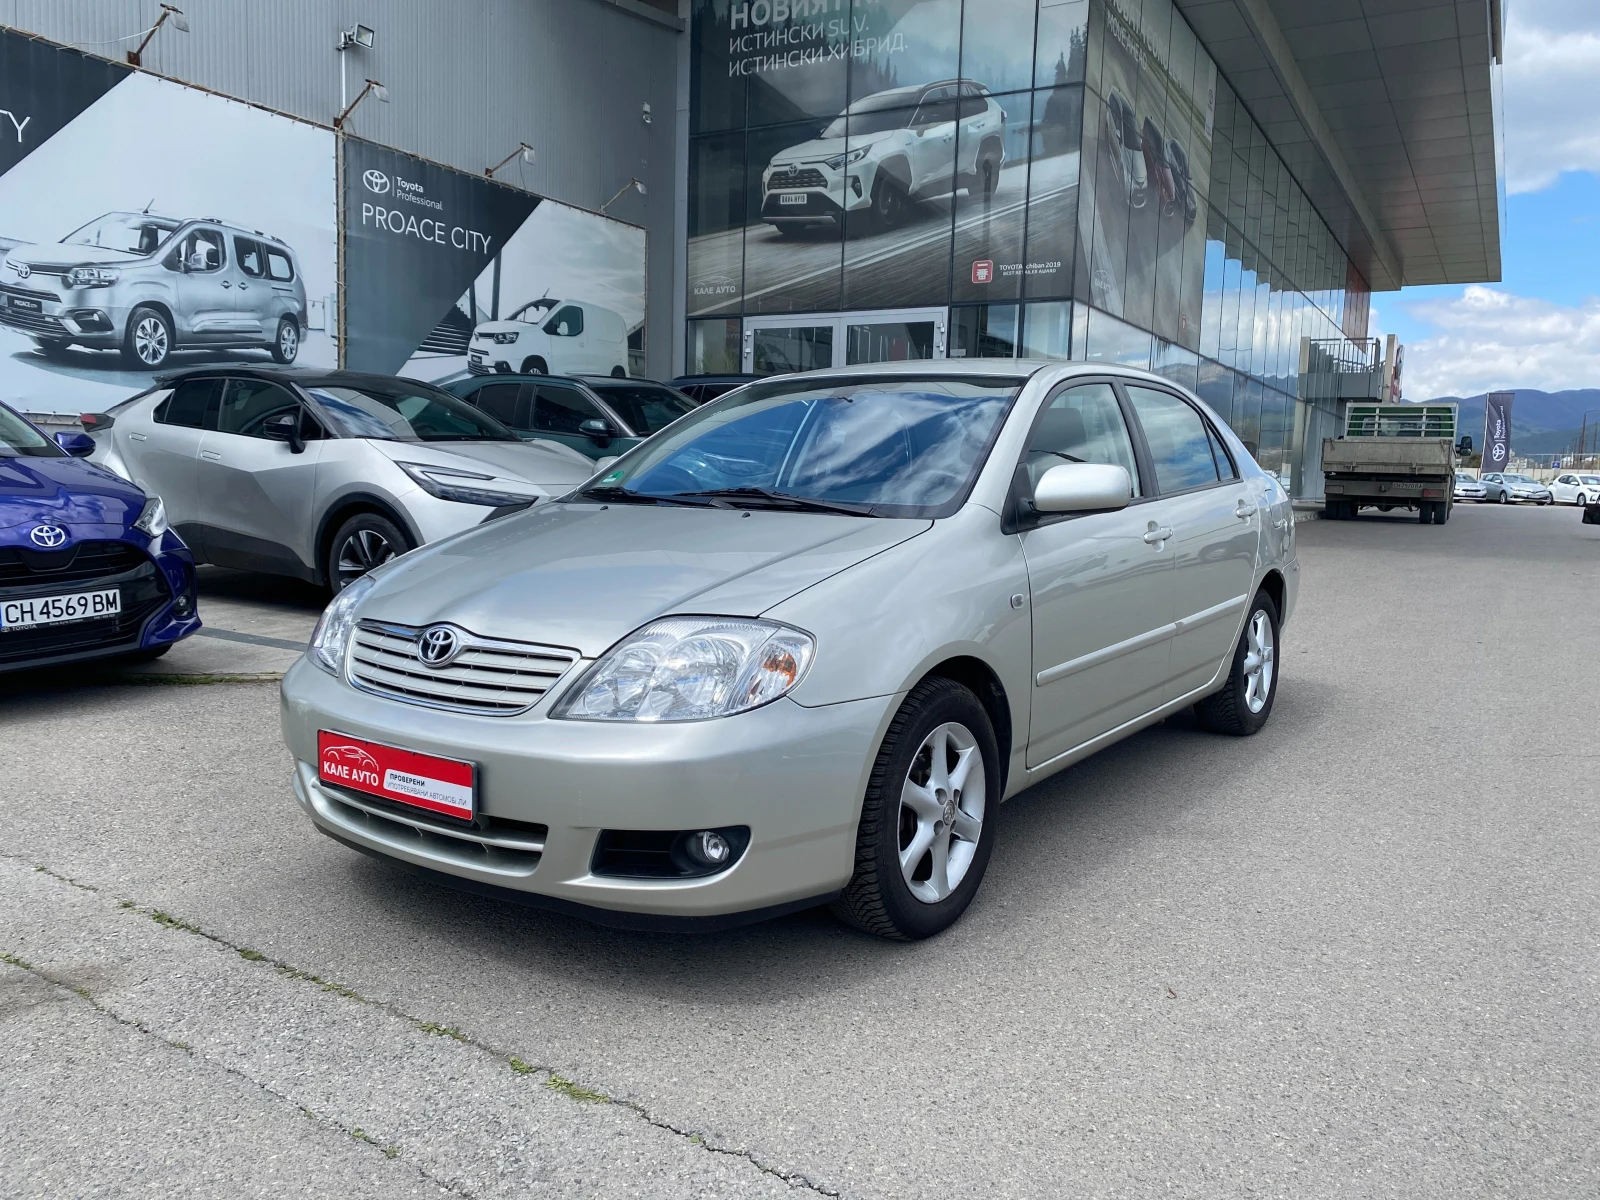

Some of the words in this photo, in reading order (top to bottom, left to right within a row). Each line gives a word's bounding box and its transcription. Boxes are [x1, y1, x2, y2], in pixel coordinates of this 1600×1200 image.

[729, 21, 824, 54] ИСТИНСКИ
[728, 45, 823, 77] ИСТИНСКИ
[827, 32, 909, 62] ХИБРИД.
[396, 176, 424, 193] Toyota
[396, 189, 443, 211] Professional
[362, 203, 446, 244] PROACE
[451, 226, 492, 254] CITY
[715, 285, 736, 294] АУТО
[1494, 419, 1502, 439] Toyota
[5, 601, 34, 623] CH
[39, 596, 88, 619] 4569
[92, 592, 118, 613] BM
[323, 760, 350, 779] КАЛЕ
[351, 768, 379, 787] АУТО
[389, 773, 426, 788] ПРОВЕРЕНИ
[387, 782, 429, 798] УПОТРЕБЯВАНИ
